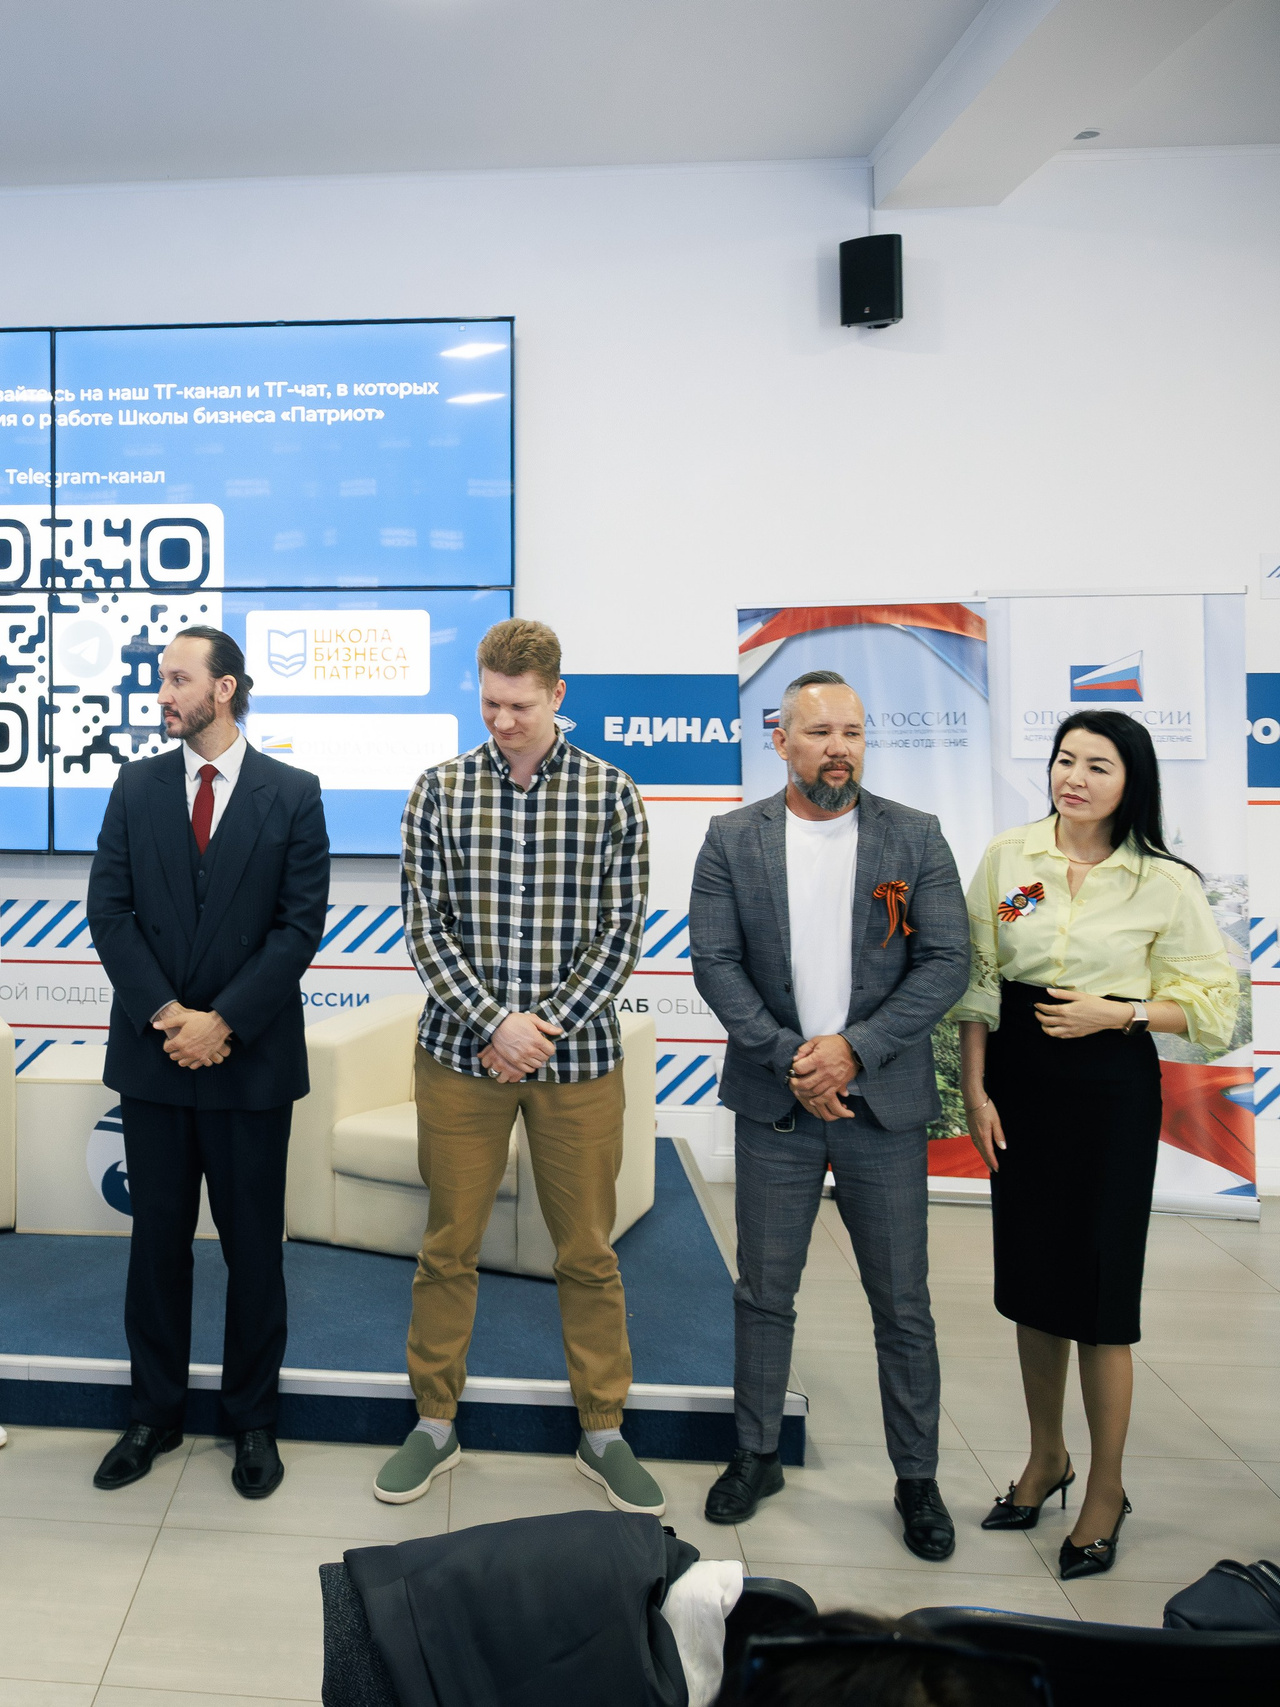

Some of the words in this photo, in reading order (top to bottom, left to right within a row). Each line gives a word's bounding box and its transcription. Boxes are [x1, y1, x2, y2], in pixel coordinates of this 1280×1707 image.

[81, 388, 102, 401] на
[107, 387, 149, 401] наш
[153, 384, 241, 400] ТГ-канал
[247, 386, 259, 398] и
[263, 382, 331, 400] ТГ-чат,
[337, 384, 348, 396] в
[353, 381, 439, 399] которых
[22, 414, 34, 428] о
[38, 407, 112, 432] работе
[118, 408, 188, 426] Школы
[193, 406, 276, 424] бизнеса
[280, 406, 385, 425] «Патриот»
[5, 469, 165, 488] Telegram-канал
[314, 628, 393, 643] ШКОЛА
[314, 647, 407, 662] БИЗНЕСА
[314, 665, 411, 680] ПАТРИОТ
[881, 711, 967, 727] РОССИИ
[1024, 710, 1071, 725] ОПО
[1024, 734, 1054, 742] АСТРАХ
[36, 985, 110, 1005] ПОДДЕ
